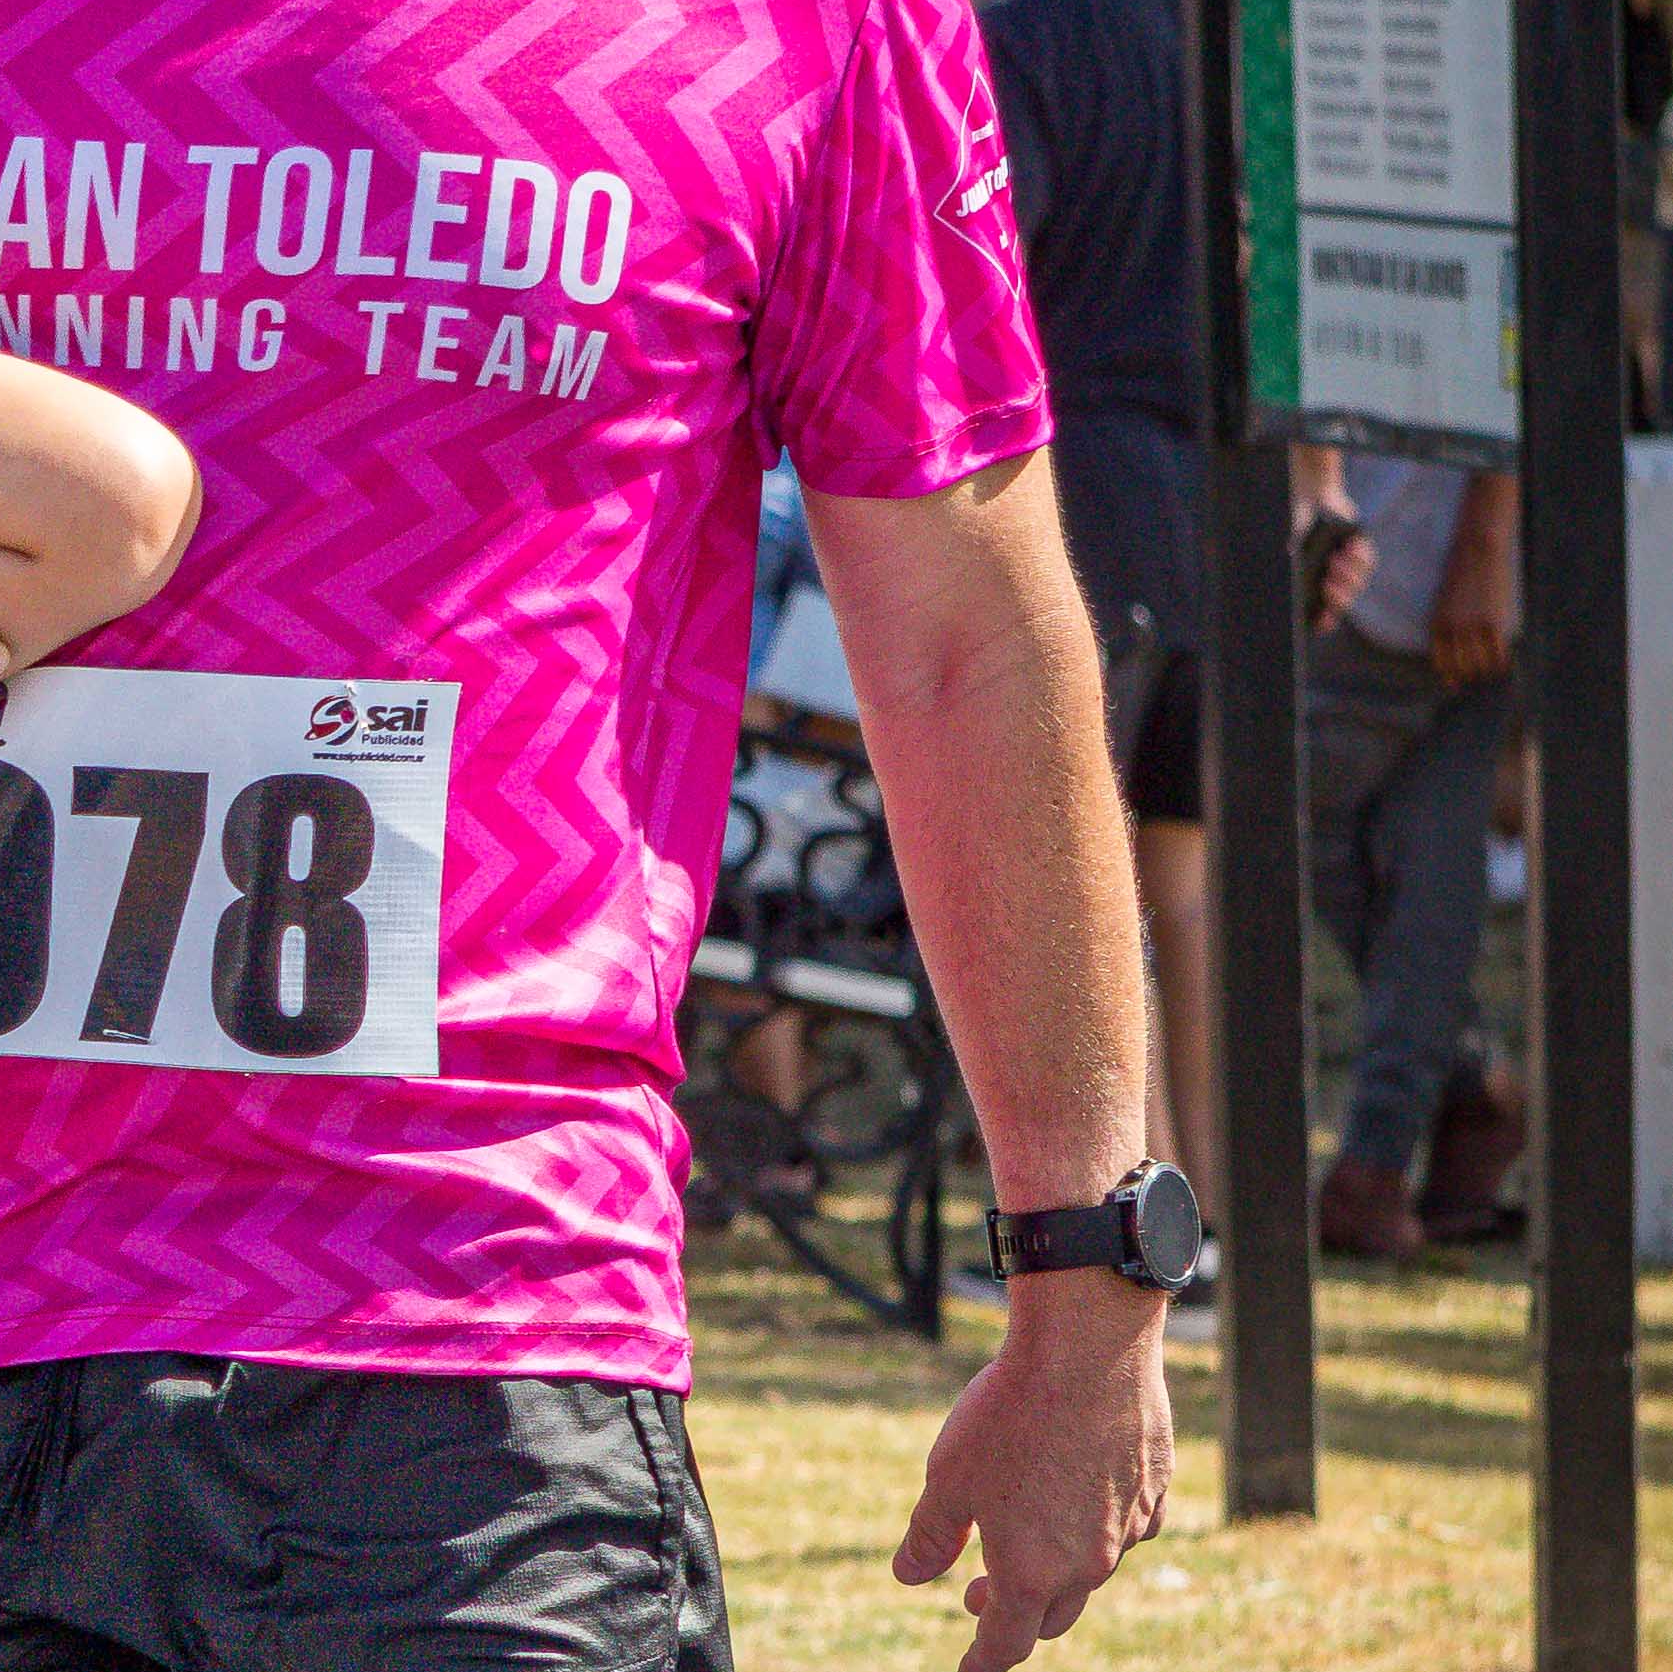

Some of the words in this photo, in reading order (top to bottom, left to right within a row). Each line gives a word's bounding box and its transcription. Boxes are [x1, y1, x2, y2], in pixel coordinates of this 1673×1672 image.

[187, 144, 633, 306] TOLEDO
[360, 300, 609, 403] TEAM
[361, 733, 424, 746] Publicidad
[366, 699, 429, 732] sai
